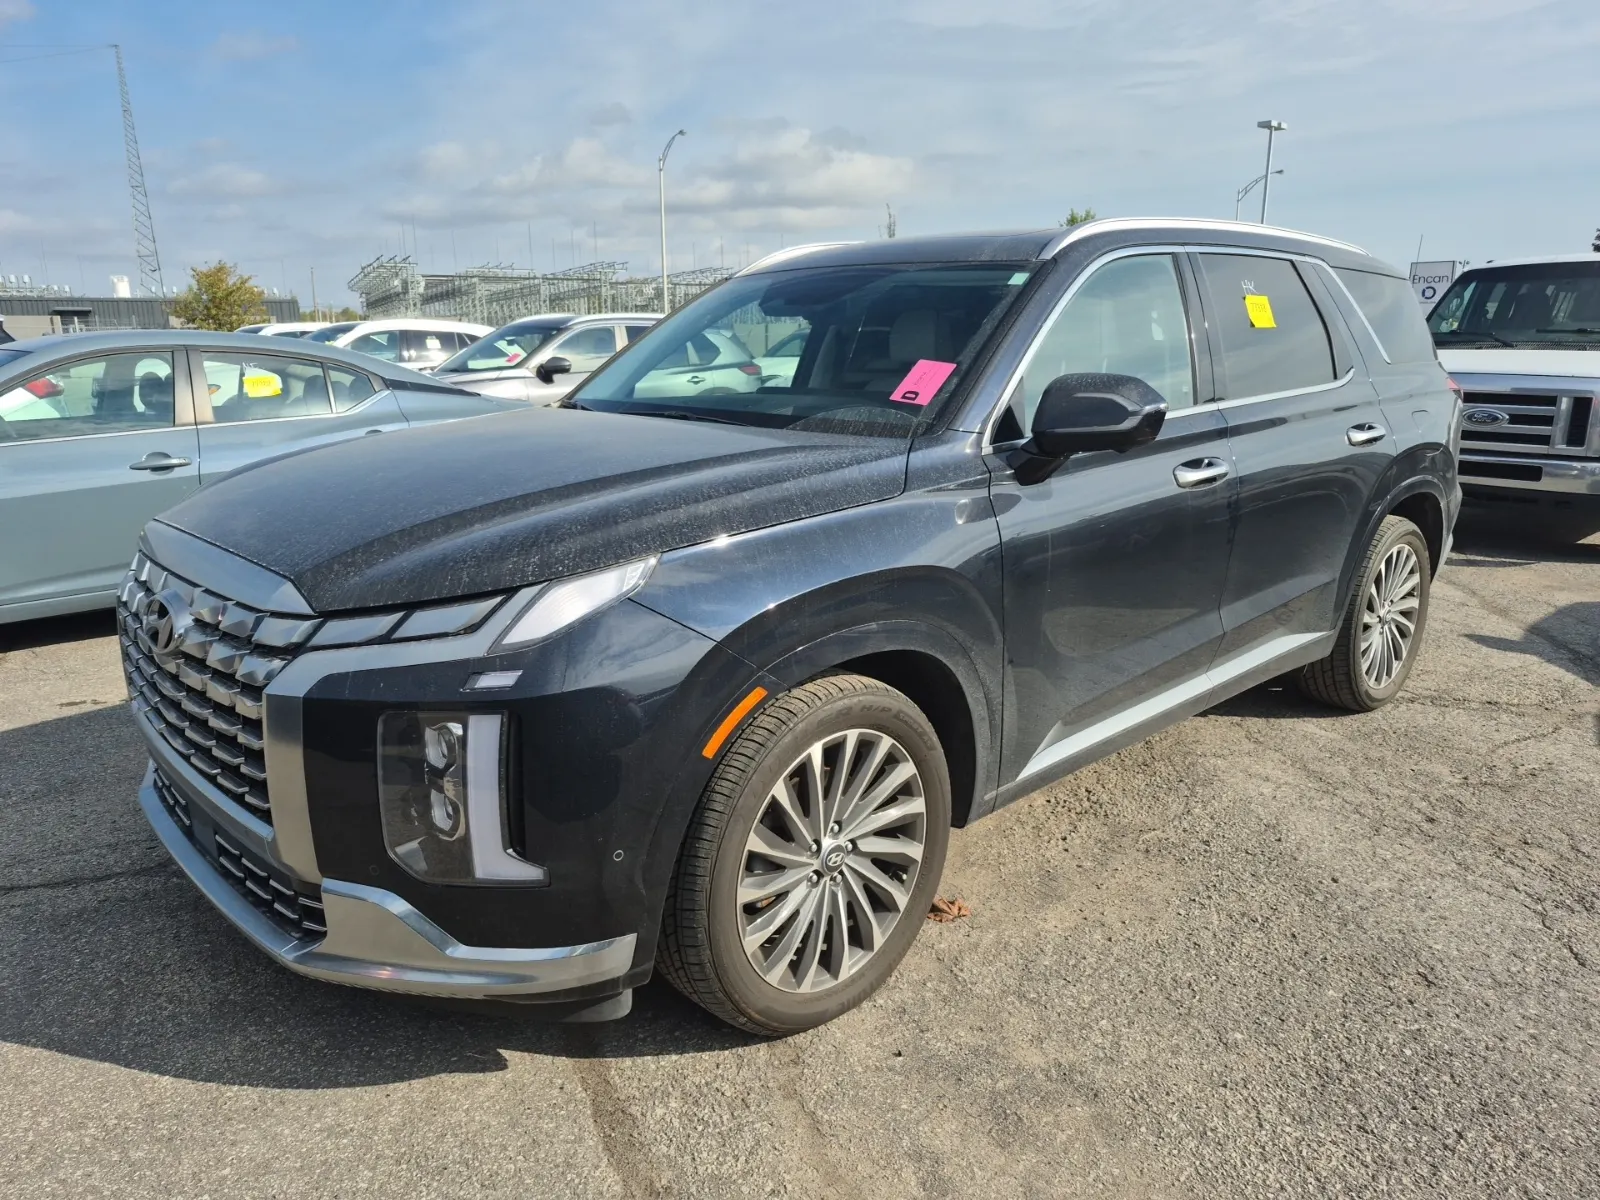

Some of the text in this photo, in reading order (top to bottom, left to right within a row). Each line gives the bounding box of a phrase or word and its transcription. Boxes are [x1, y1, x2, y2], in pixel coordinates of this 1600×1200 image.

[1412, 274, 1449, 284] Encan
[901, 391, 919, 401] D
[1472, 413, 1493, 422] Ford
